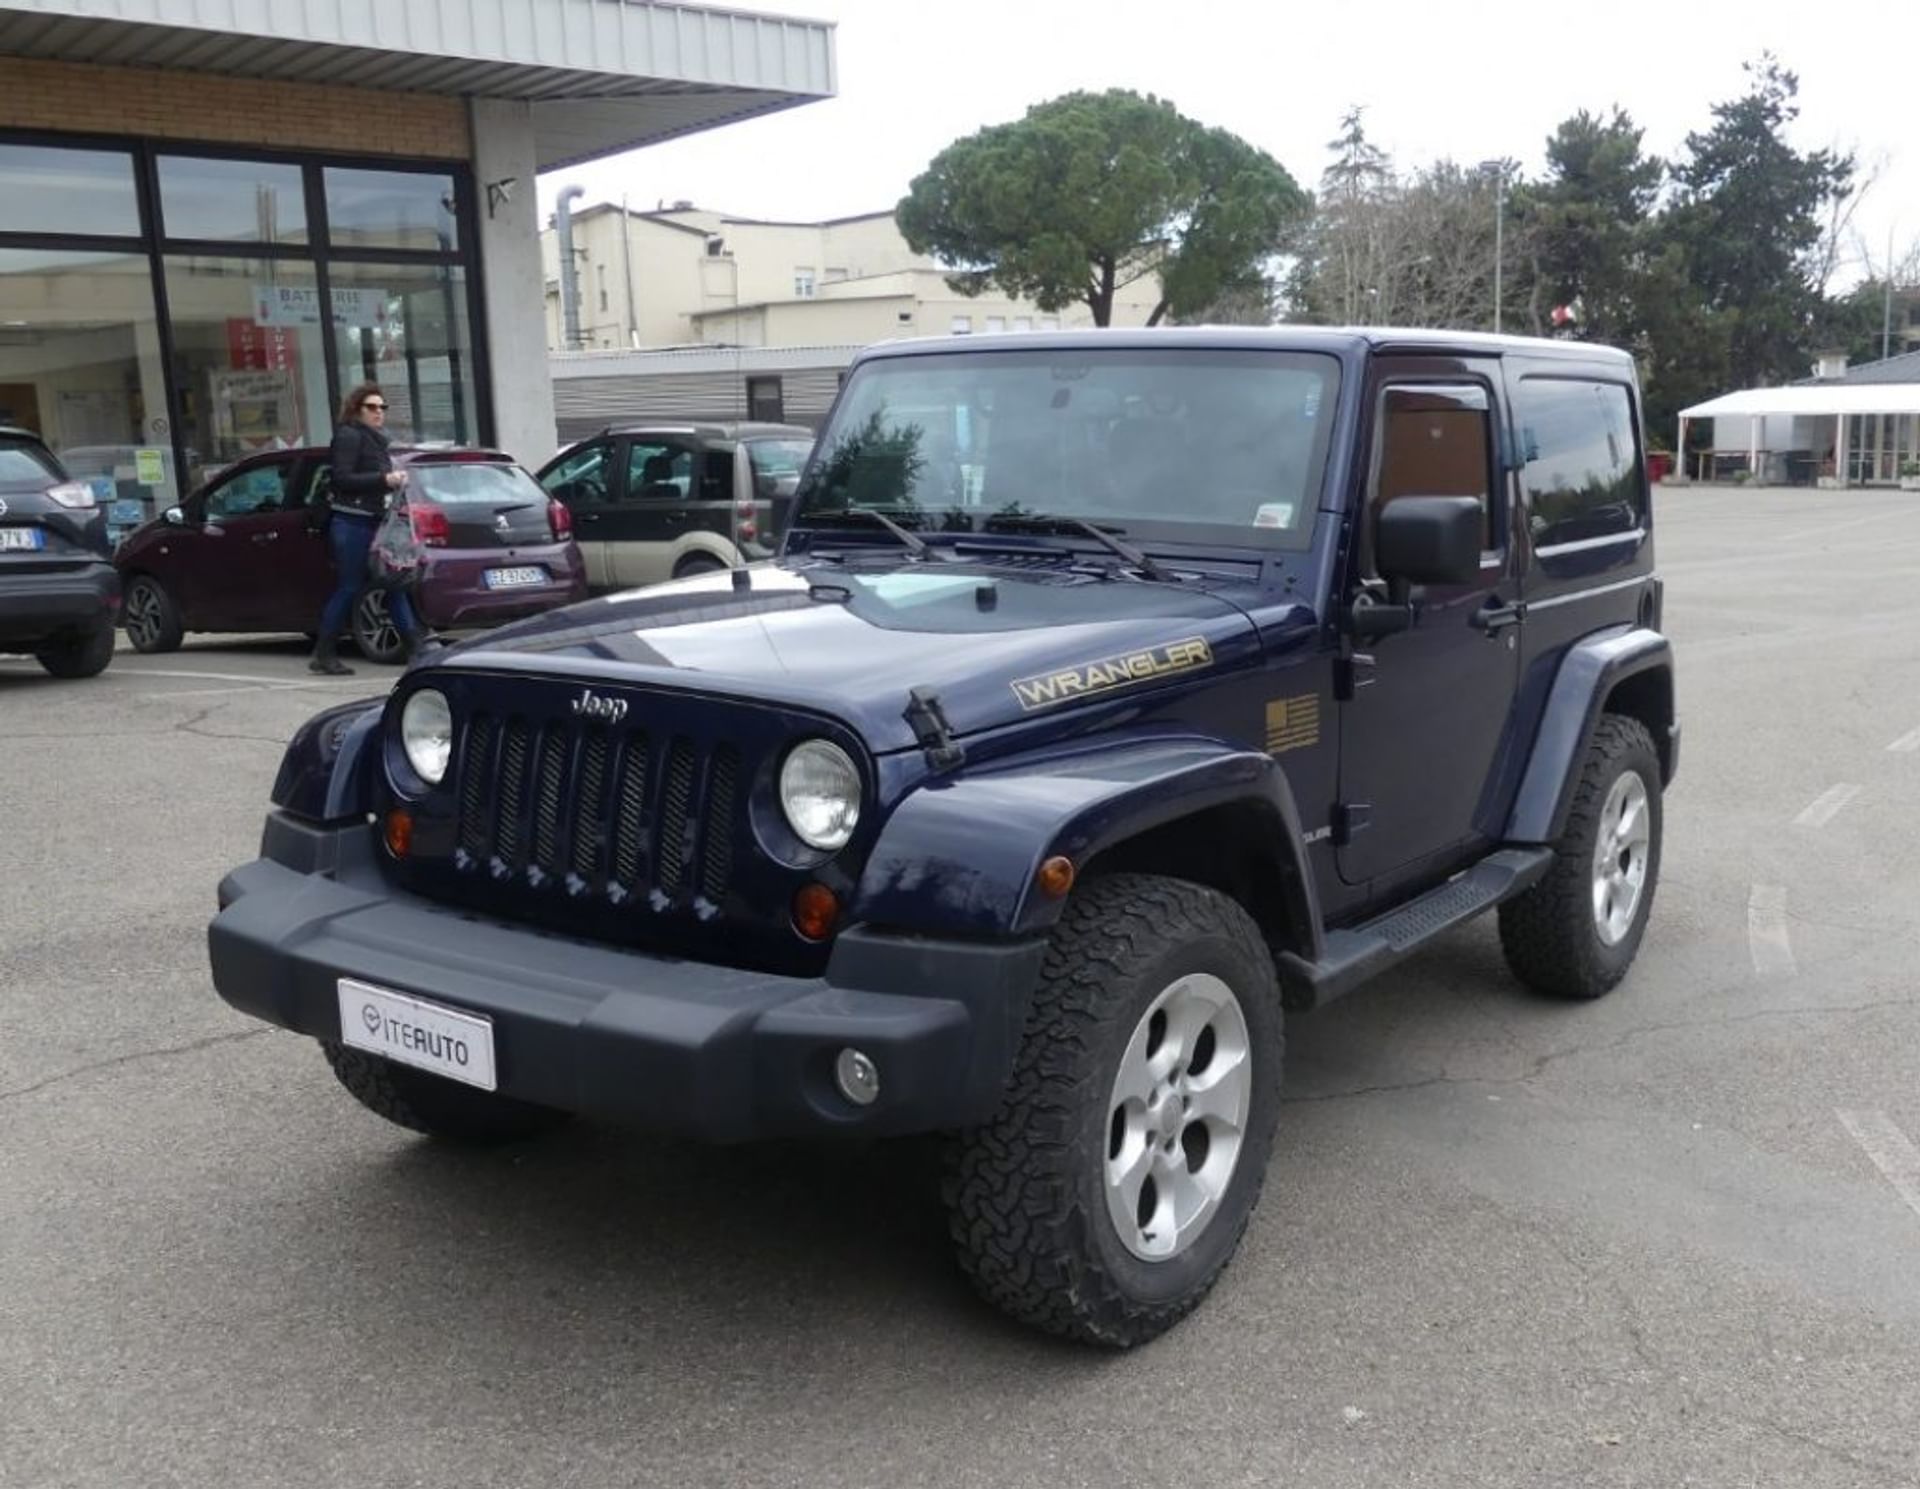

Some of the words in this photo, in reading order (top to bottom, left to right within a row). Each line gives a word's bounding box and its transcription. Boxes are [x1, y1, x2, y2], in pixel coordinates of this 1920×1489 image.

[280, 289, 360, 303] BATRIE
[1019, 641, 1210, 702] WRANGLER
[571, 690, 628, 725] Jeep
